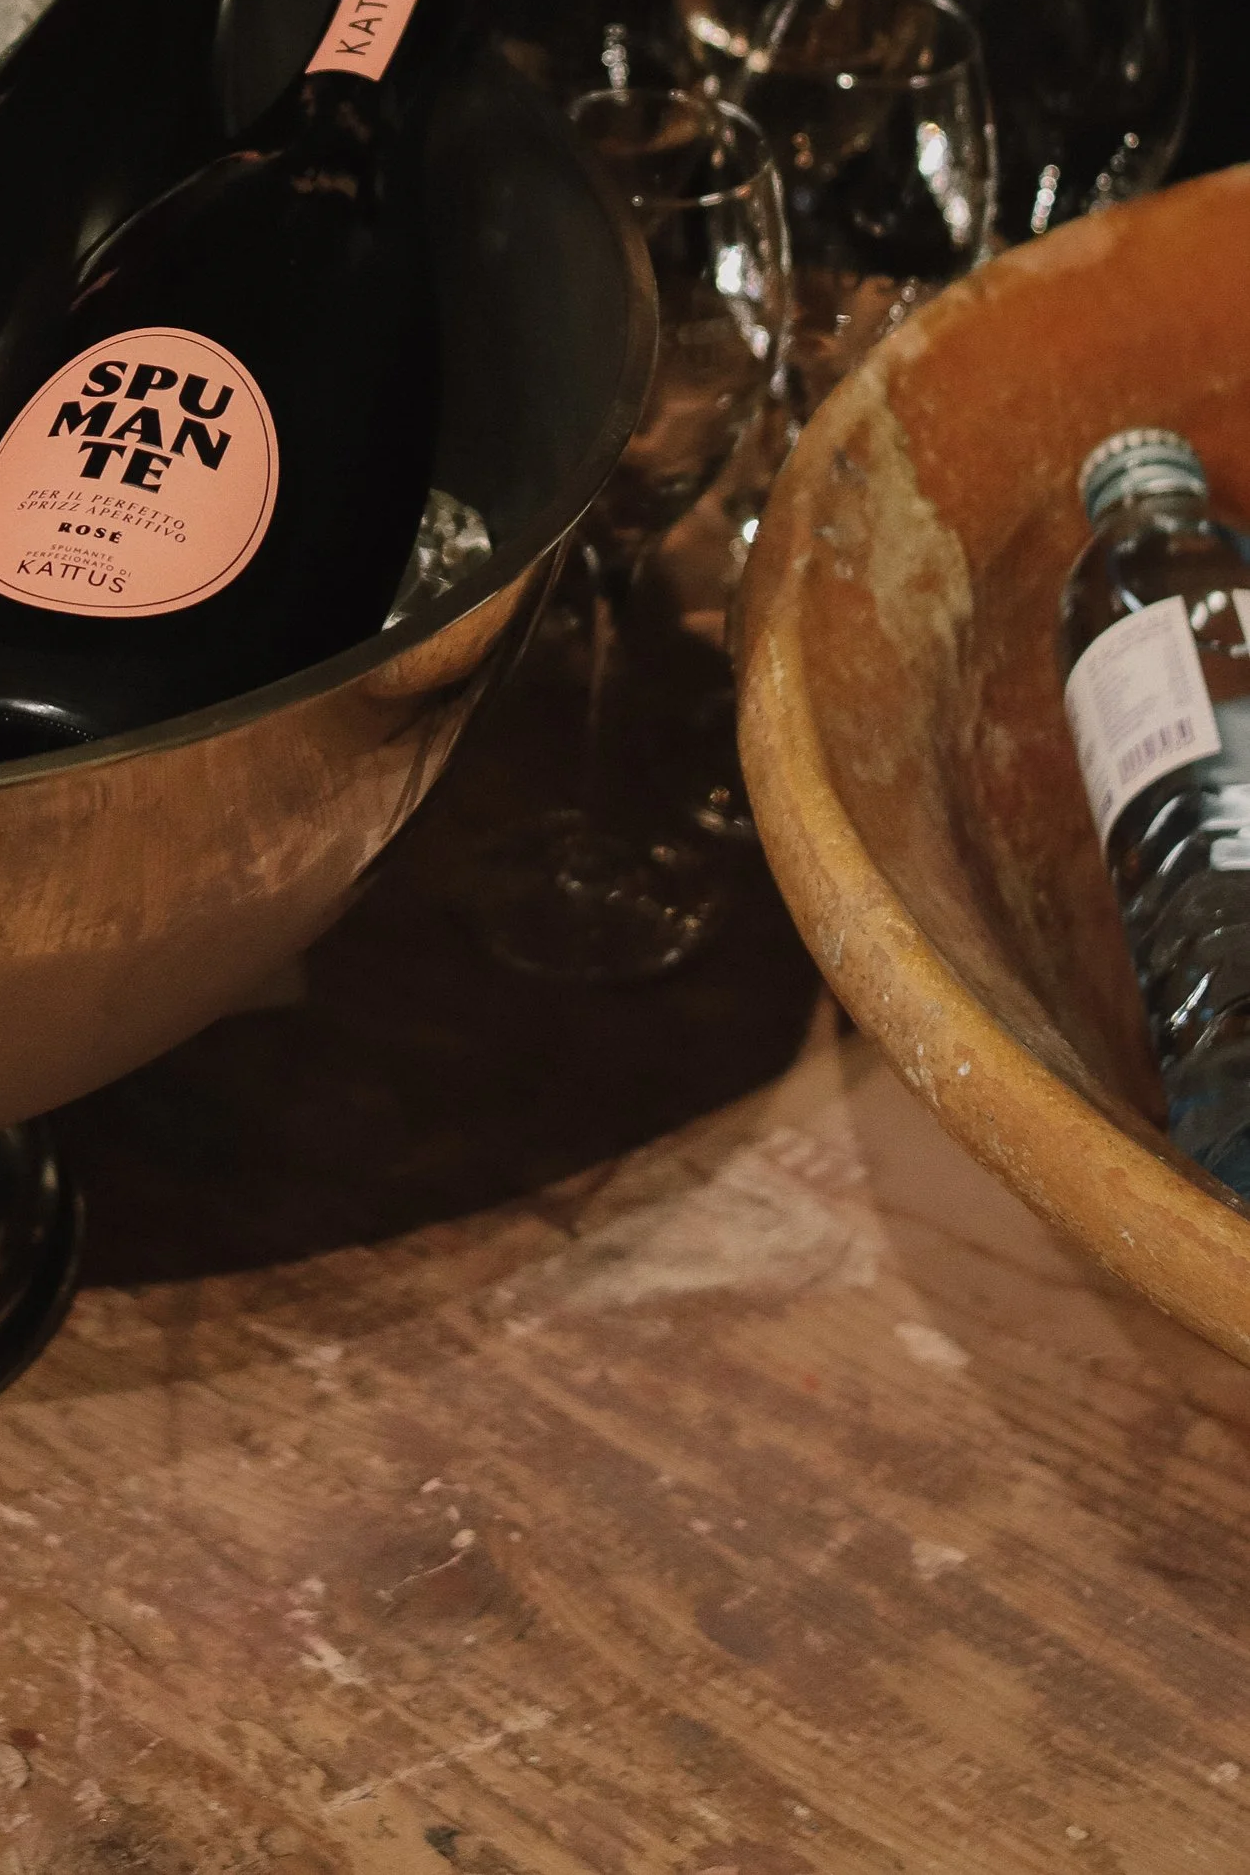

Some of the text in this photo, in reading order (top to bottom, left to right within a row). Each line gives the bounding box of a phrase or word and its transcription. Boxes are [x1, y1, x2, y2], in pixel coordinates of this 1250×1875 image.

[81, 360, 235, 420] SPU
[47, 400, 232, 471] MAN
[78, 440, 173, 494] TE
[17, 500, 187, 543] SPRIZZ APERITIVO
[27, 489, 185, 531] PER IL PERFETTO
[51, 543, 115, 562] SPUMANTE
[58, 521, 123, 544] ROSÉ
[17, 559, 126, 594] KATTUS
[25, 551, 132, 578] PERFEZIONATO DI
